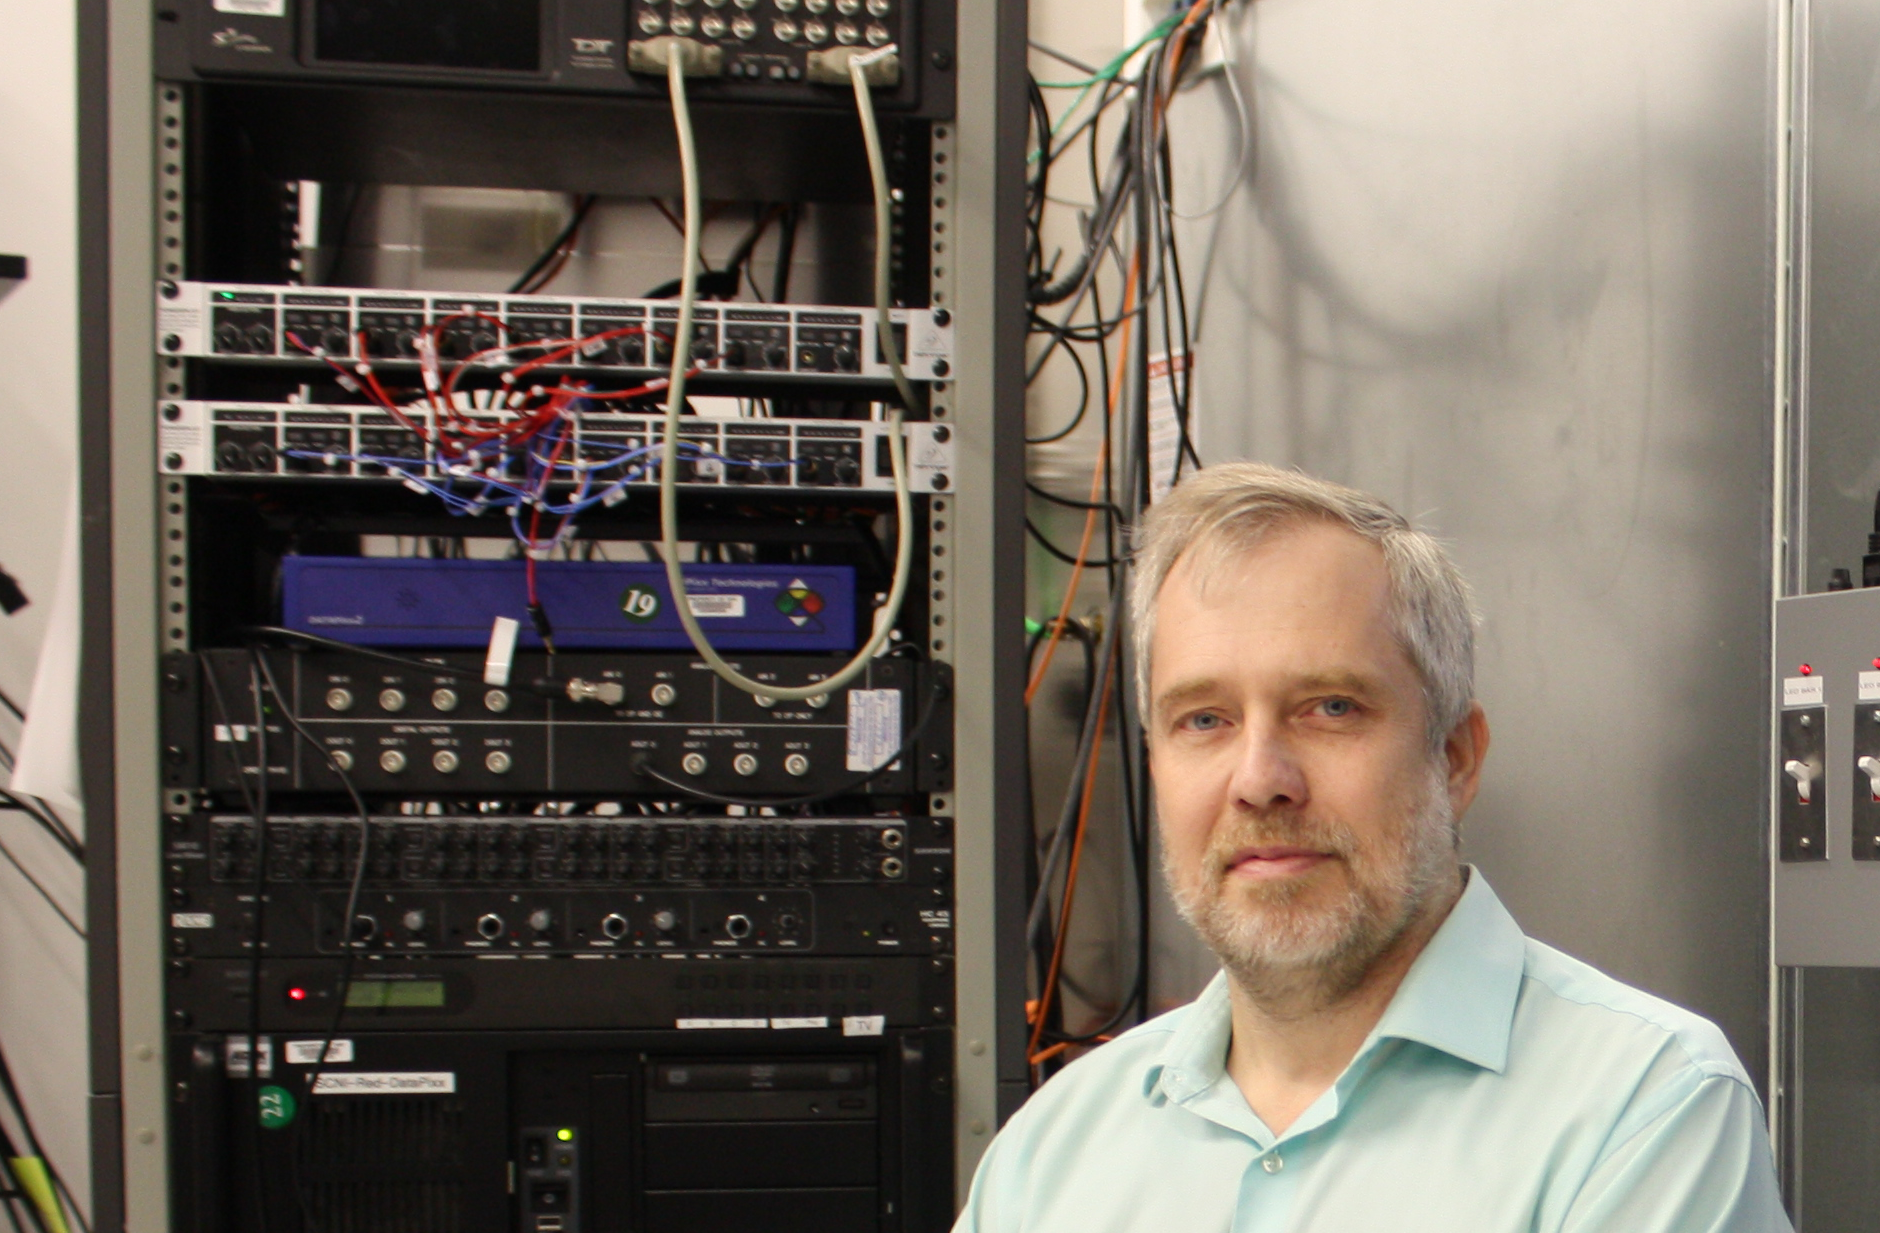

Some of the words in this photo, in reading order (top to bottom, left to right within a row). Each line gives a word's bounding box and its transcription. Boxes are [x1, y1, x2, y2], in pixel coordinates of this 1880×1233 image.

[711, 578, 780, 590] Technologies
[623, 589, 657, 617] 19
[857, 1020, 873, 1031] TV
[259, 1093, 284, 1119] 22
